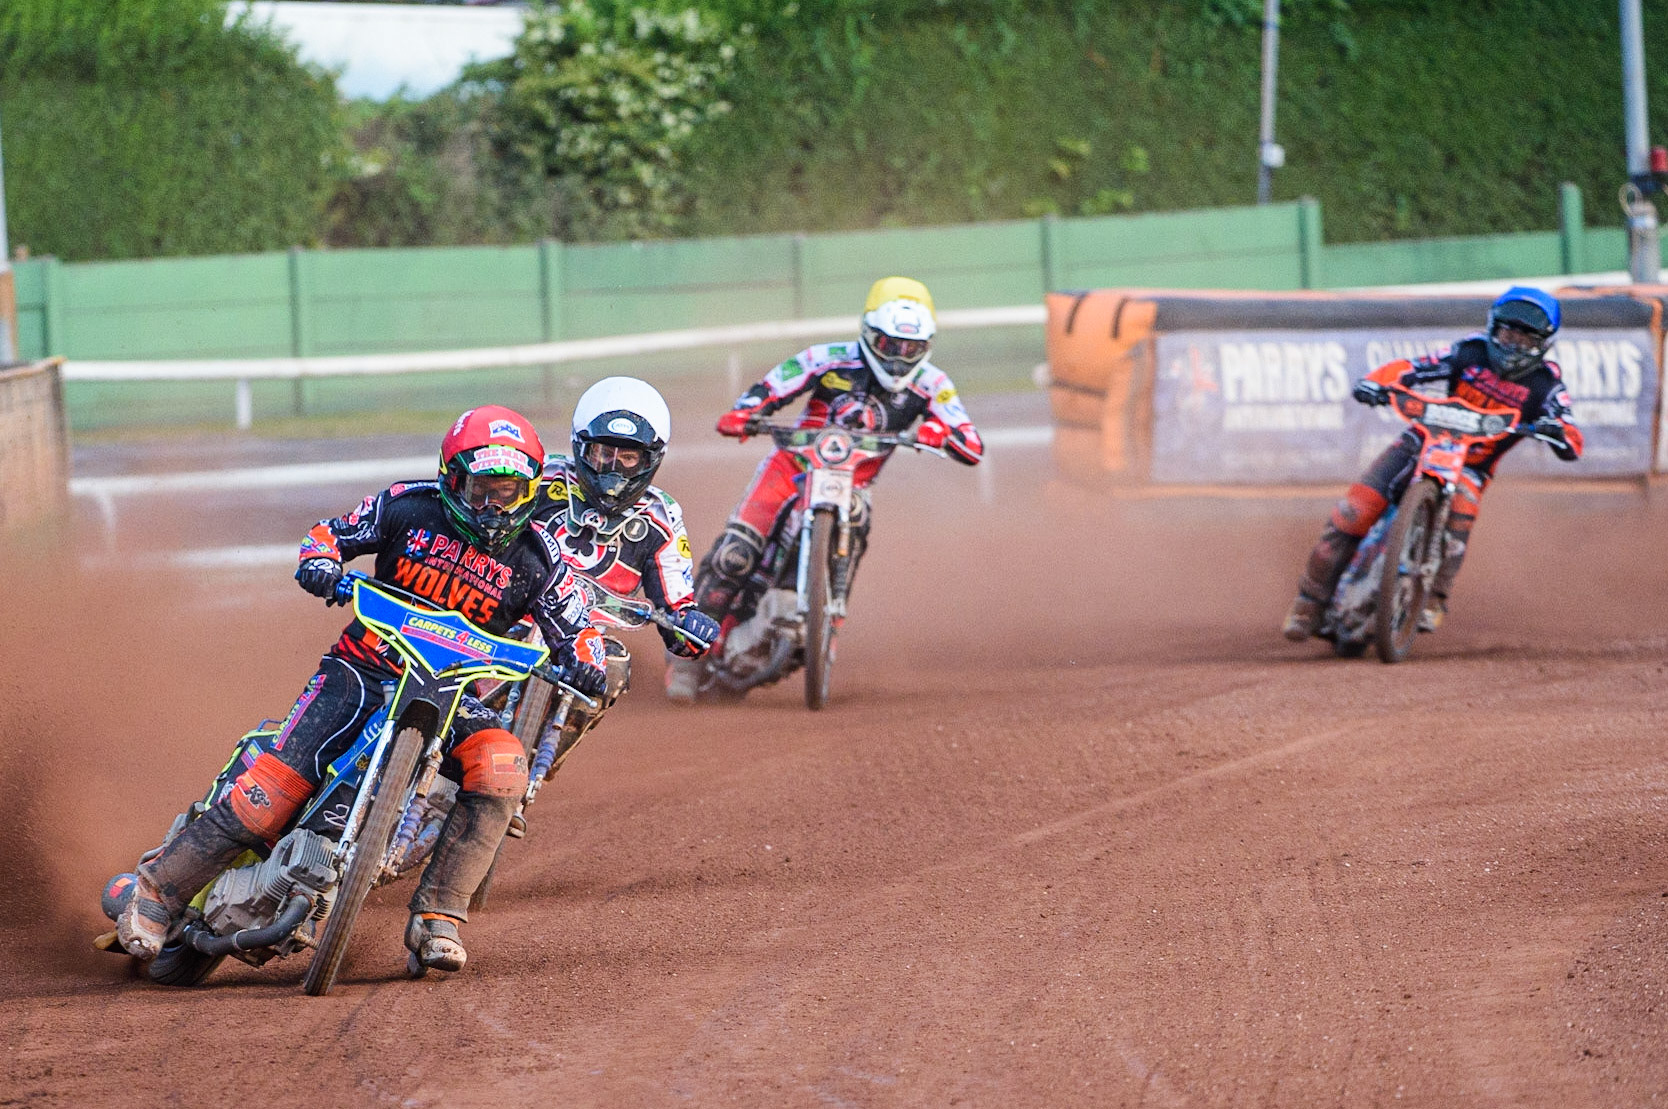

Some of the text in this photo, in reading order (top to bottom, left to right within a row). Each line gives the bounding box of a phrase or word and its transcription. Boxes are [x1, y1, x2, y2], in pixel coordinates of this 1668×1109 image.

[1220, 341, 1348, 400] PARRYS
[471, 458, 501, 471] WITH
[514, 461, 533, 477] VAN
[476, 448, 526, 463] THE MAN
[424, 556, 503, 600] INTERNATIONAL
[429, 534, 512, 589] PARRYS
[394, 556, 499, 624] WOLVES
[408, 617, 457, 639] CARPETS
[456, 631, 470, 644] 4
[466, 637, 493, 653] LESS
